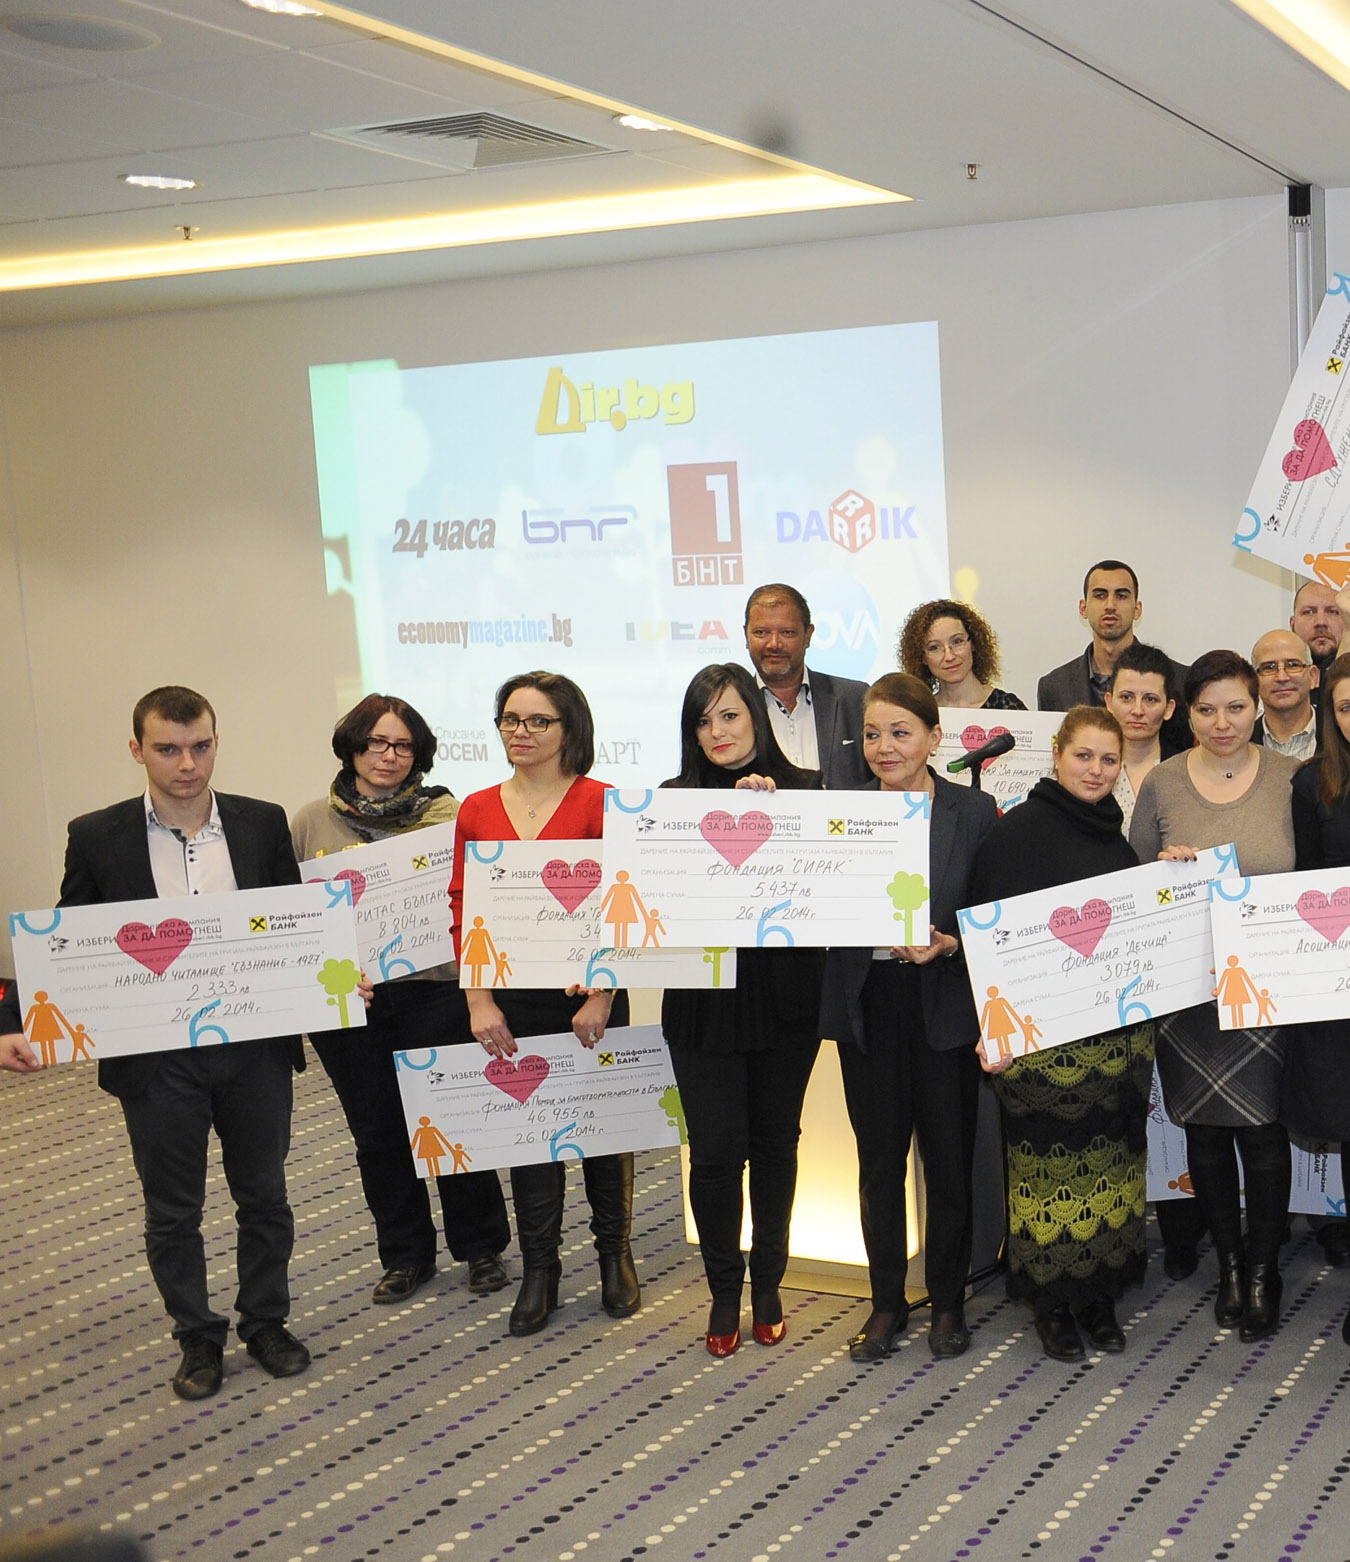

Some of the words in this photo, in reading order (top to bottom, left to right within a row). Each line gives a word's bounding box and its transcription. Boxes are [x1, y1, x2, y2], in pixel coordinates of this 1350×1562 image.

[1299, 394, 1326, 447] ПОМОГНЕШ
[1294, 448, 1306, 463] ДА
[1289, 463, 1300, 476] ЗА
[705, 474, 732, 543] 1
[521, 509, 629, 544] bnr
[392, 518, 428, 558] 24
[433, 518, 496, 551] часа
[676, 559, 737, 584] БНТ
[398, 613, 573, 648] economymagazine.bg
[811, 609, 878, 650] OVA
[435, 726, 486, 740] Списание
[965, 732, 975, 740] ЗА
[976, 733, 988, 742] ДА
[706, 821, 719, 830] ЗА
[722, 821, 738, 831] ДА
[741, 820, 801, 831] ПОМОГНЕШ
[846, 818, 898, 827] Райфайзен
[847, 827, 874, 835] БАНК
[349, 868, 390, 886] МОГНЕШ
[547, 869, 558, 878] ЗА
[560, 869, 573, 879] ДА
[575, 868, 601, 878] ПОМО
[1174, 889, 1196, 901] БАНК
[1302, 900, 1315, 910] ЗА
[1317, 898, 1332, 910] ДА
[268, 911, 322, 922] Райфайзен
[1054, 918, 1067, 928] ЗА
[1069, 913, 1083, 926] ДА
[1083, 900, 1135, 920] ПОМОГНЕШ
[270, 920, 297, 930] БАНК
[122, 933, 137, 943] ЗА
[140, 930, 157, 942] ДА
[159, 924, 222, 938] ПОМОГНЕШ
[114, 970, 167, 987] НАРОДНО
[171, 964, 226, 981] ЧИТАЛИЩЕ
[614, 1047, 662, 1057] Райфайзен
[616, 1055, 640, 1064] БАНК
[490, 1067, 502, 1076] ЗА
[505, 1065, 519, 1075] ДА
[520, 1059, 575, 1072] ПОМОГНЕШ
